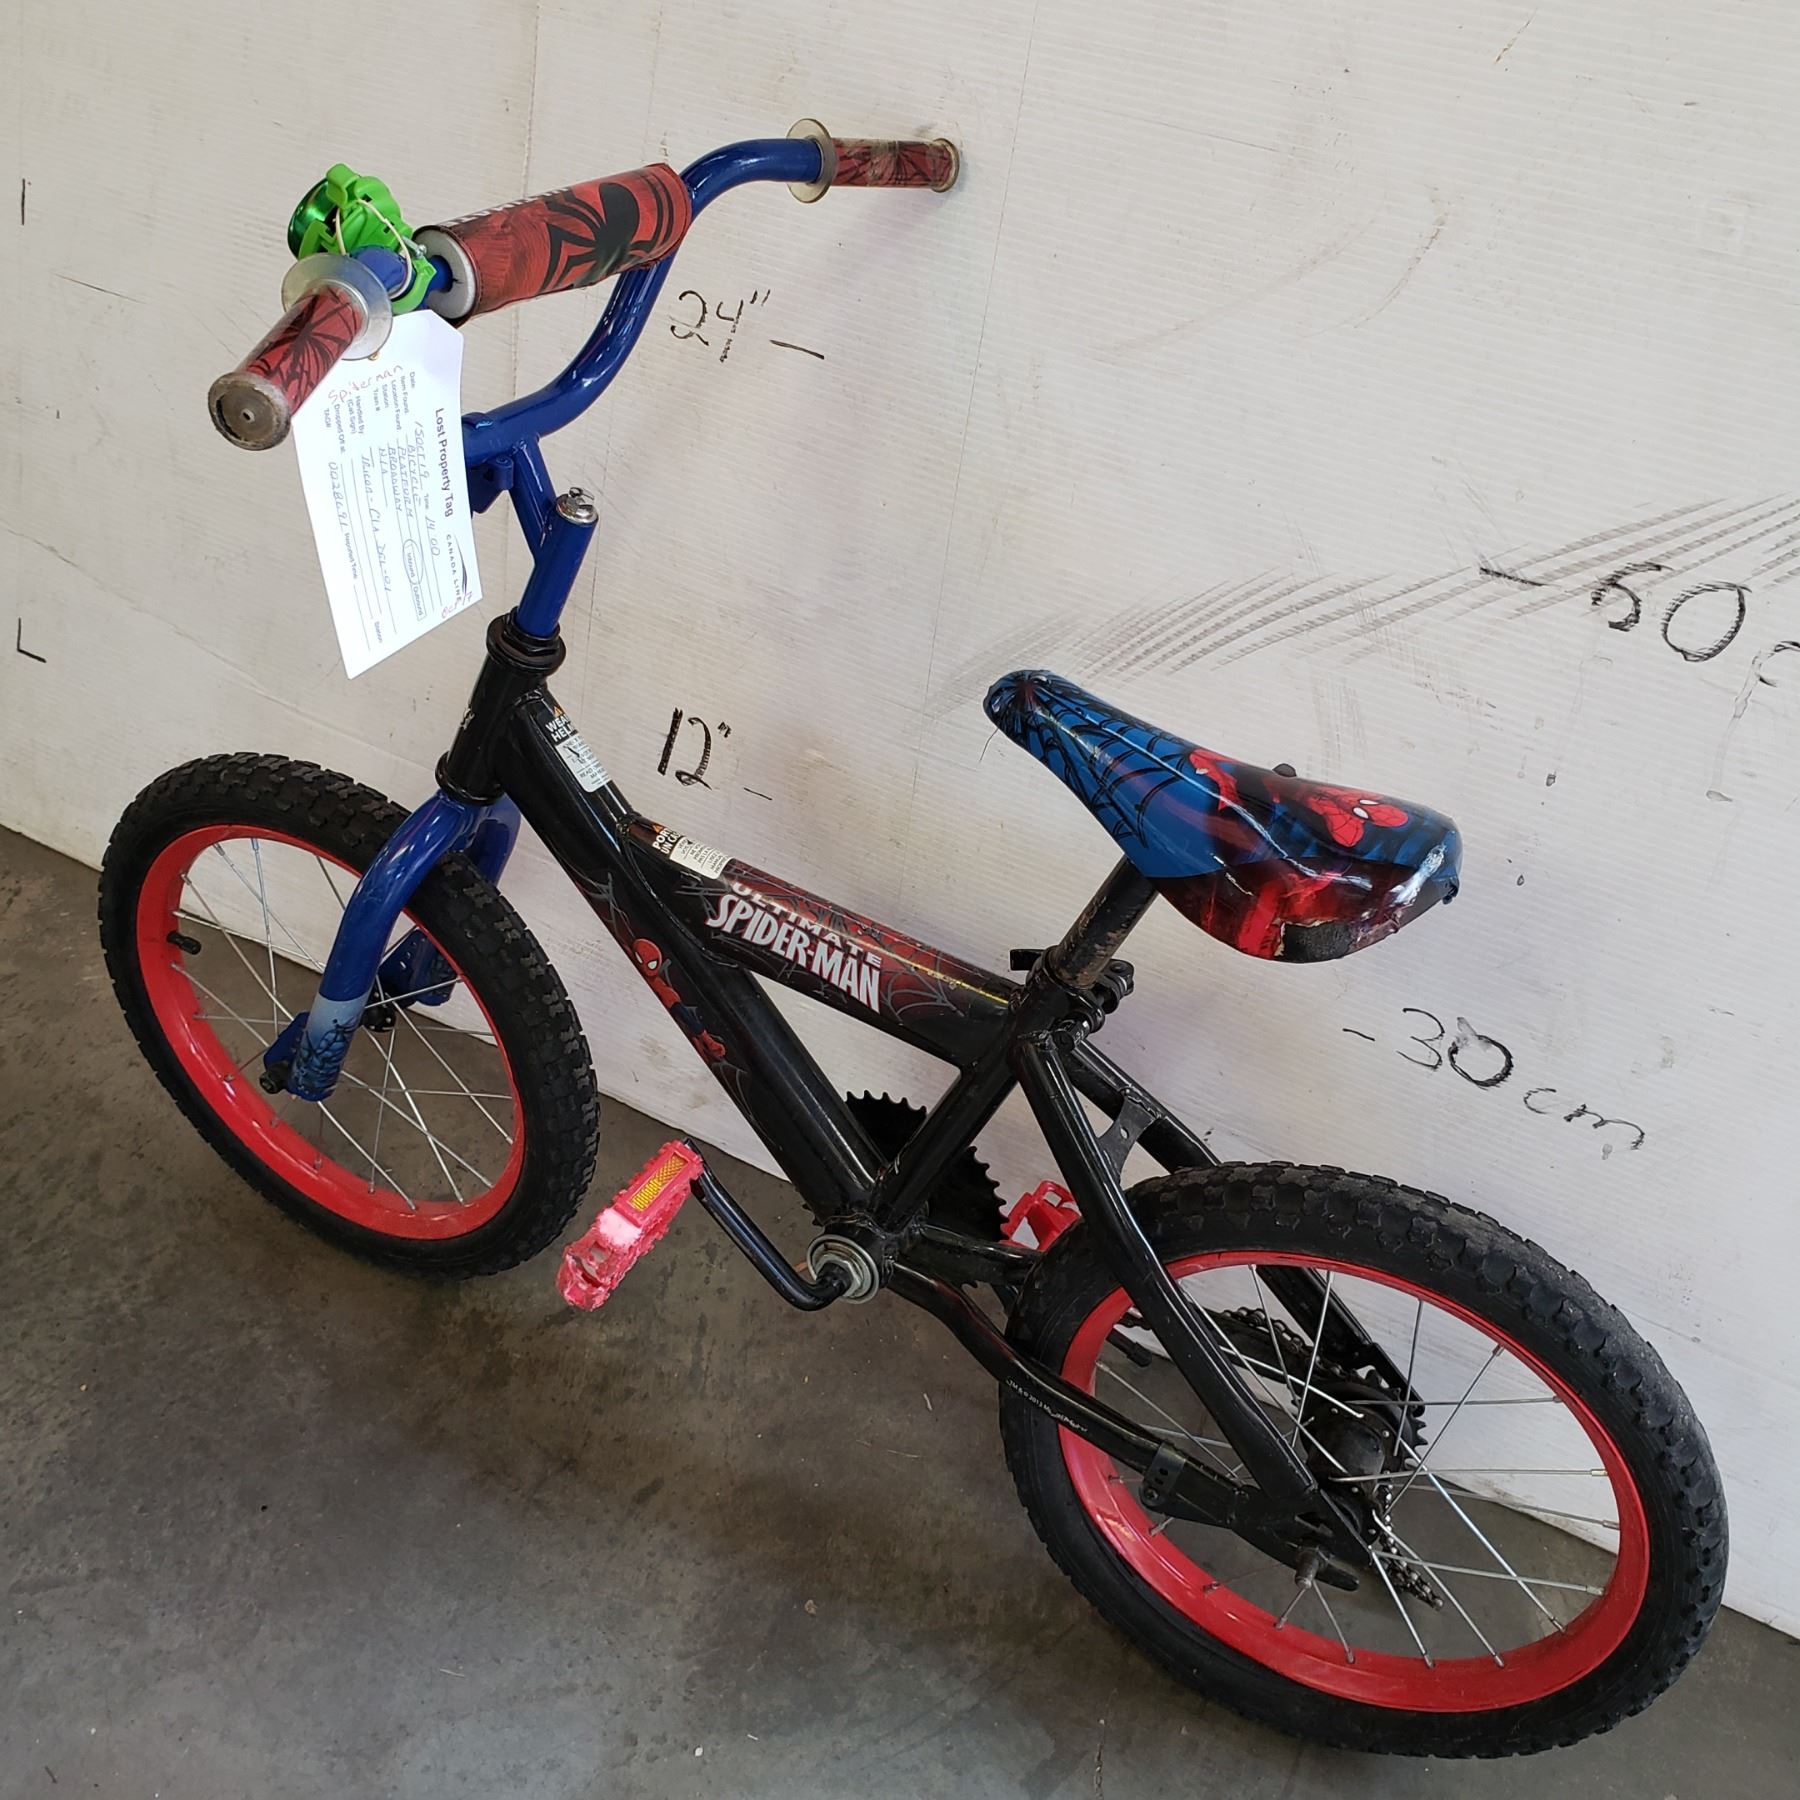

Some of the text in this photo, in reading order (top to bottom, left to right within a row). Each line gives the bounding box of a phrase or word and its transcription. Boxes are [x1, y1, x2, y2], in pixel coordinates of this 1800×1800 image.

[334, 403, 343, 433] Dropped
[391, 379, 399, 408] Location
[388, 447, 402, 512] BROADWAY
[407, 444, 421, 506] BICYCLE
[435, 407, 454, 518] Lost Property Tag
[413, 586, 424, 616] Outbound
[446, 534, 462, 601] CANADA LINE
[657, 707, 732, 790] 12"
[705, 893, 881, 1014] SPIDER-MAN
[732, 882, 882, 969] ULTIMATE
[1396, 1007, 1645, 1151] 30 cm
